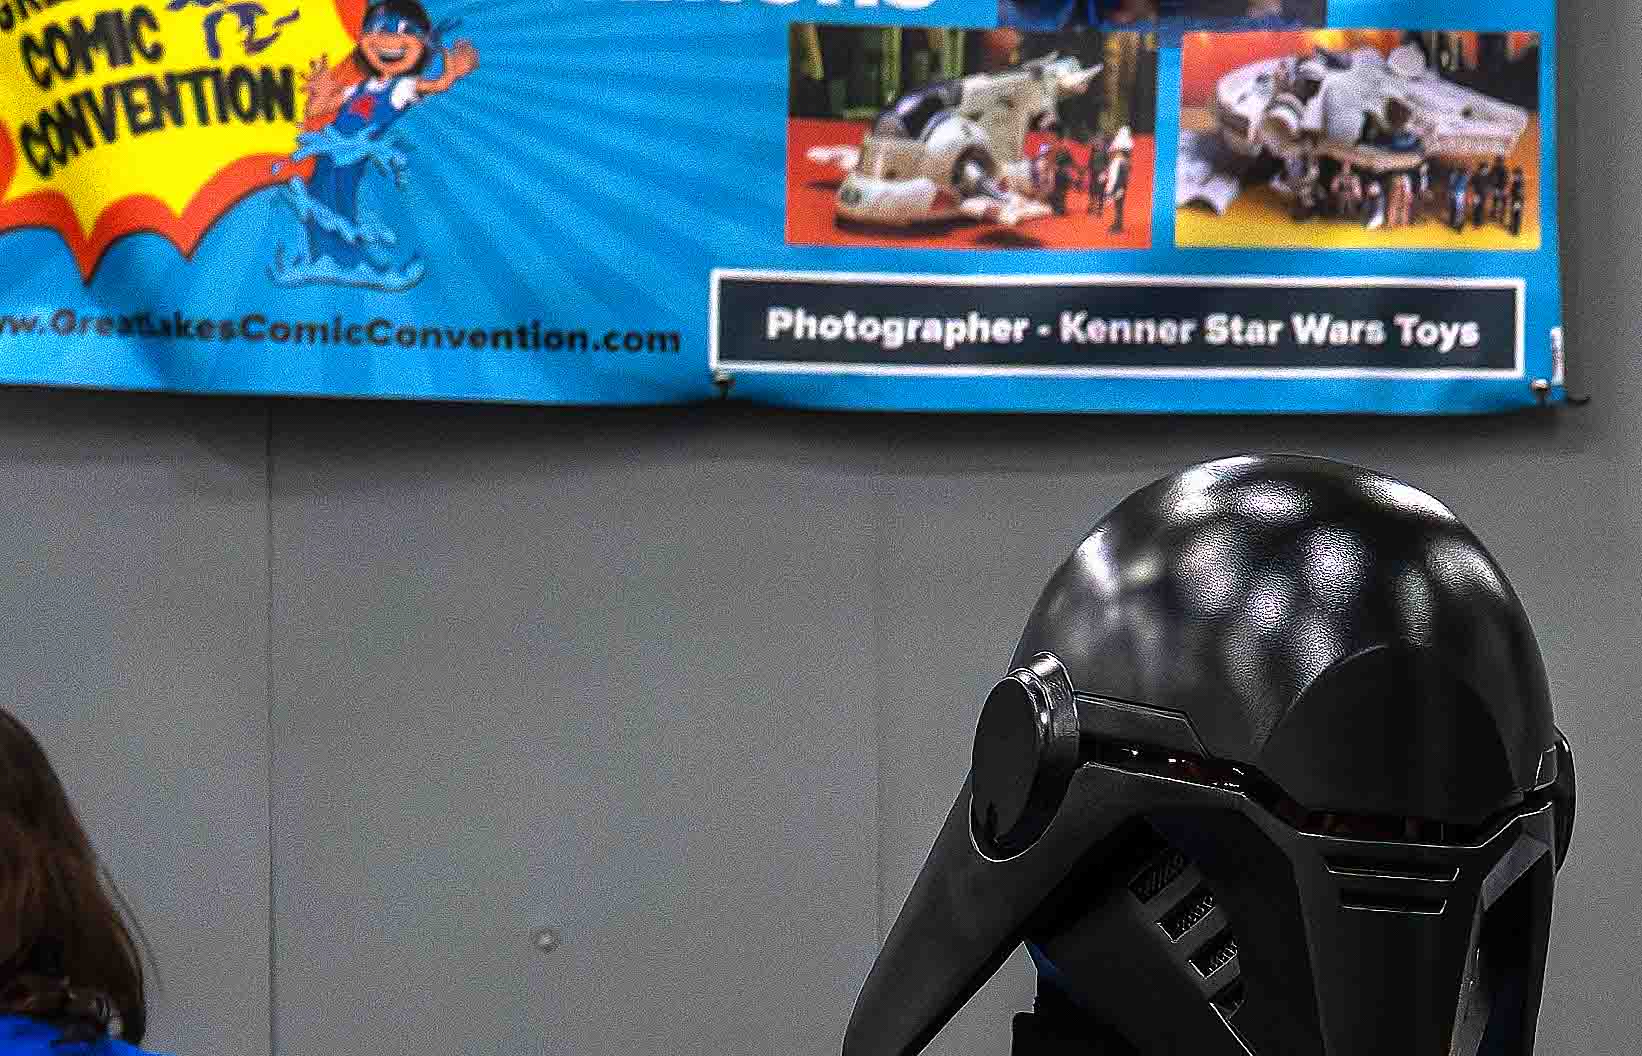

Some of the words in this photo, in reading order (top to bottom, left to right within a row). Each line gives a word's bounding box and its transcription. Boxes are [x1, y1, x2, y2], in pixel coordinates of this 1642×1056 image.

[20, 5, 162, 88] COMIC
[20, 65, 295, 178] CONVENTION
[767, 309, 1029, 348] Photographer
[1060, 312, 1194, 344] Kenner
[1204, 314, 1281, 345] Star
[1294, 316, 1385, 345] Wars
[1396, 315, 1480, 350] Toys
